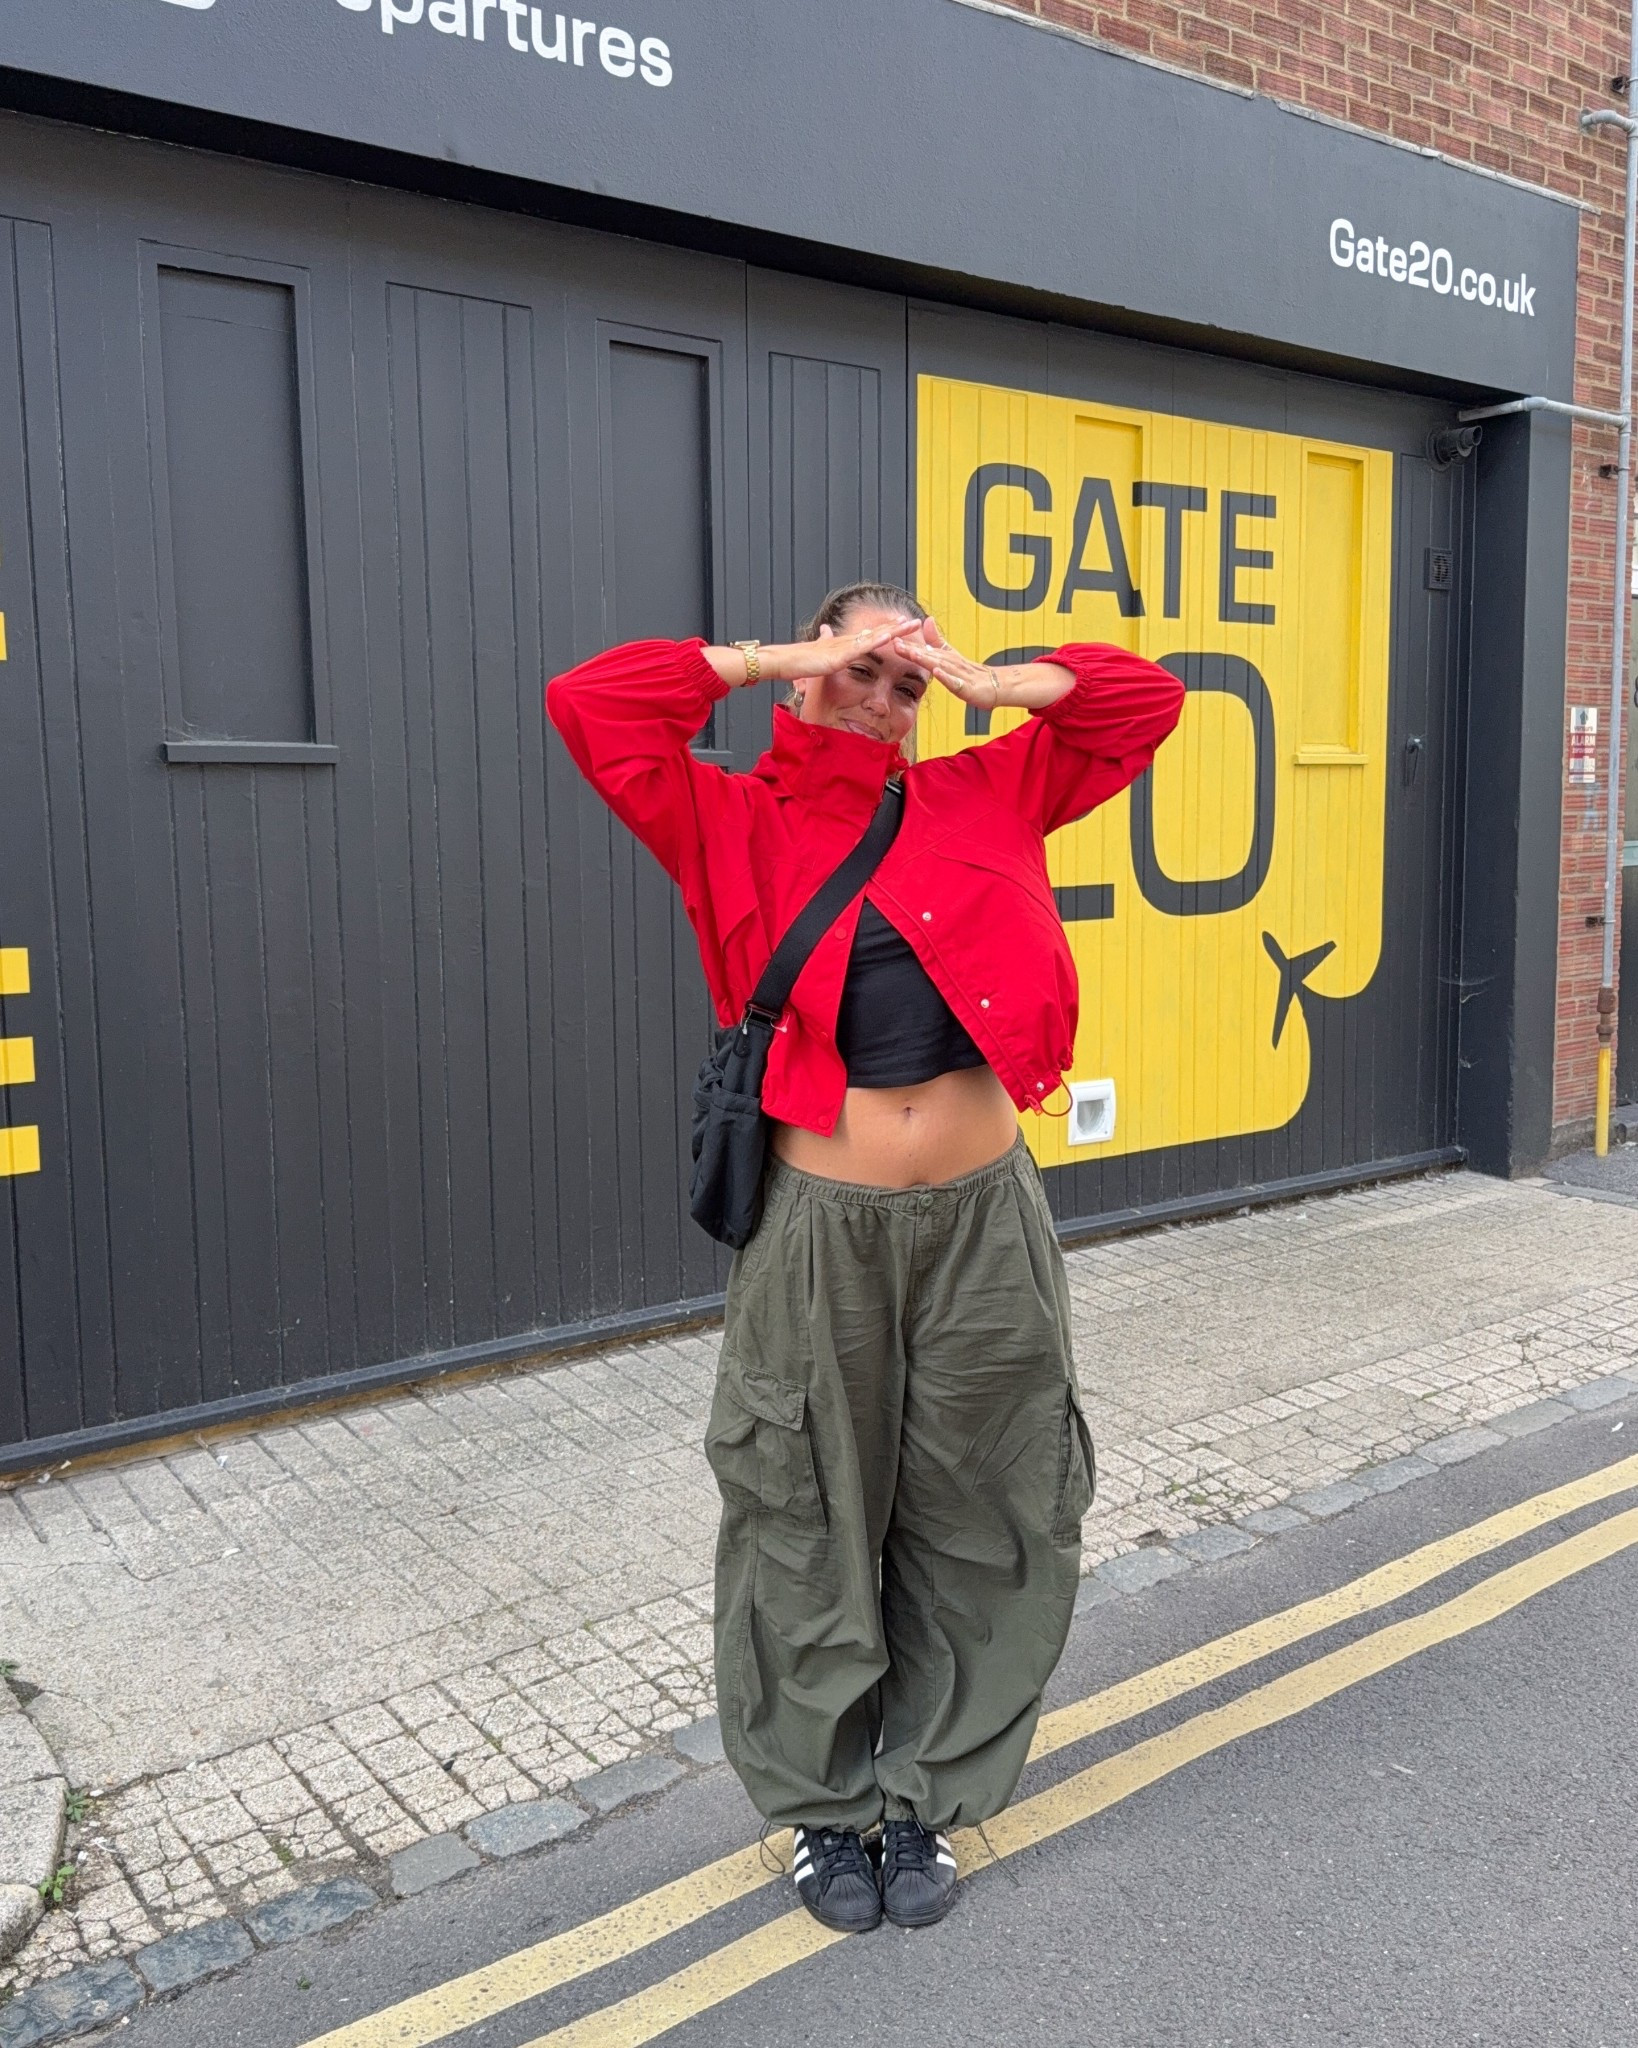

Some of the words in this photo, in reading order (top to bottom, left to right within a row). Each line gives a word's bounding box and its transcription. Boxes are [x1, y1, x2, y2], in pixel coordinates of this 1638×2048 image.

[336, 0, 672, 87] partures
[1329, 218, 1537, 317] Gate20.co.uk
[963, 462, 1277, 625] GATE
[1571, 735, 1596, 746] ALARM
